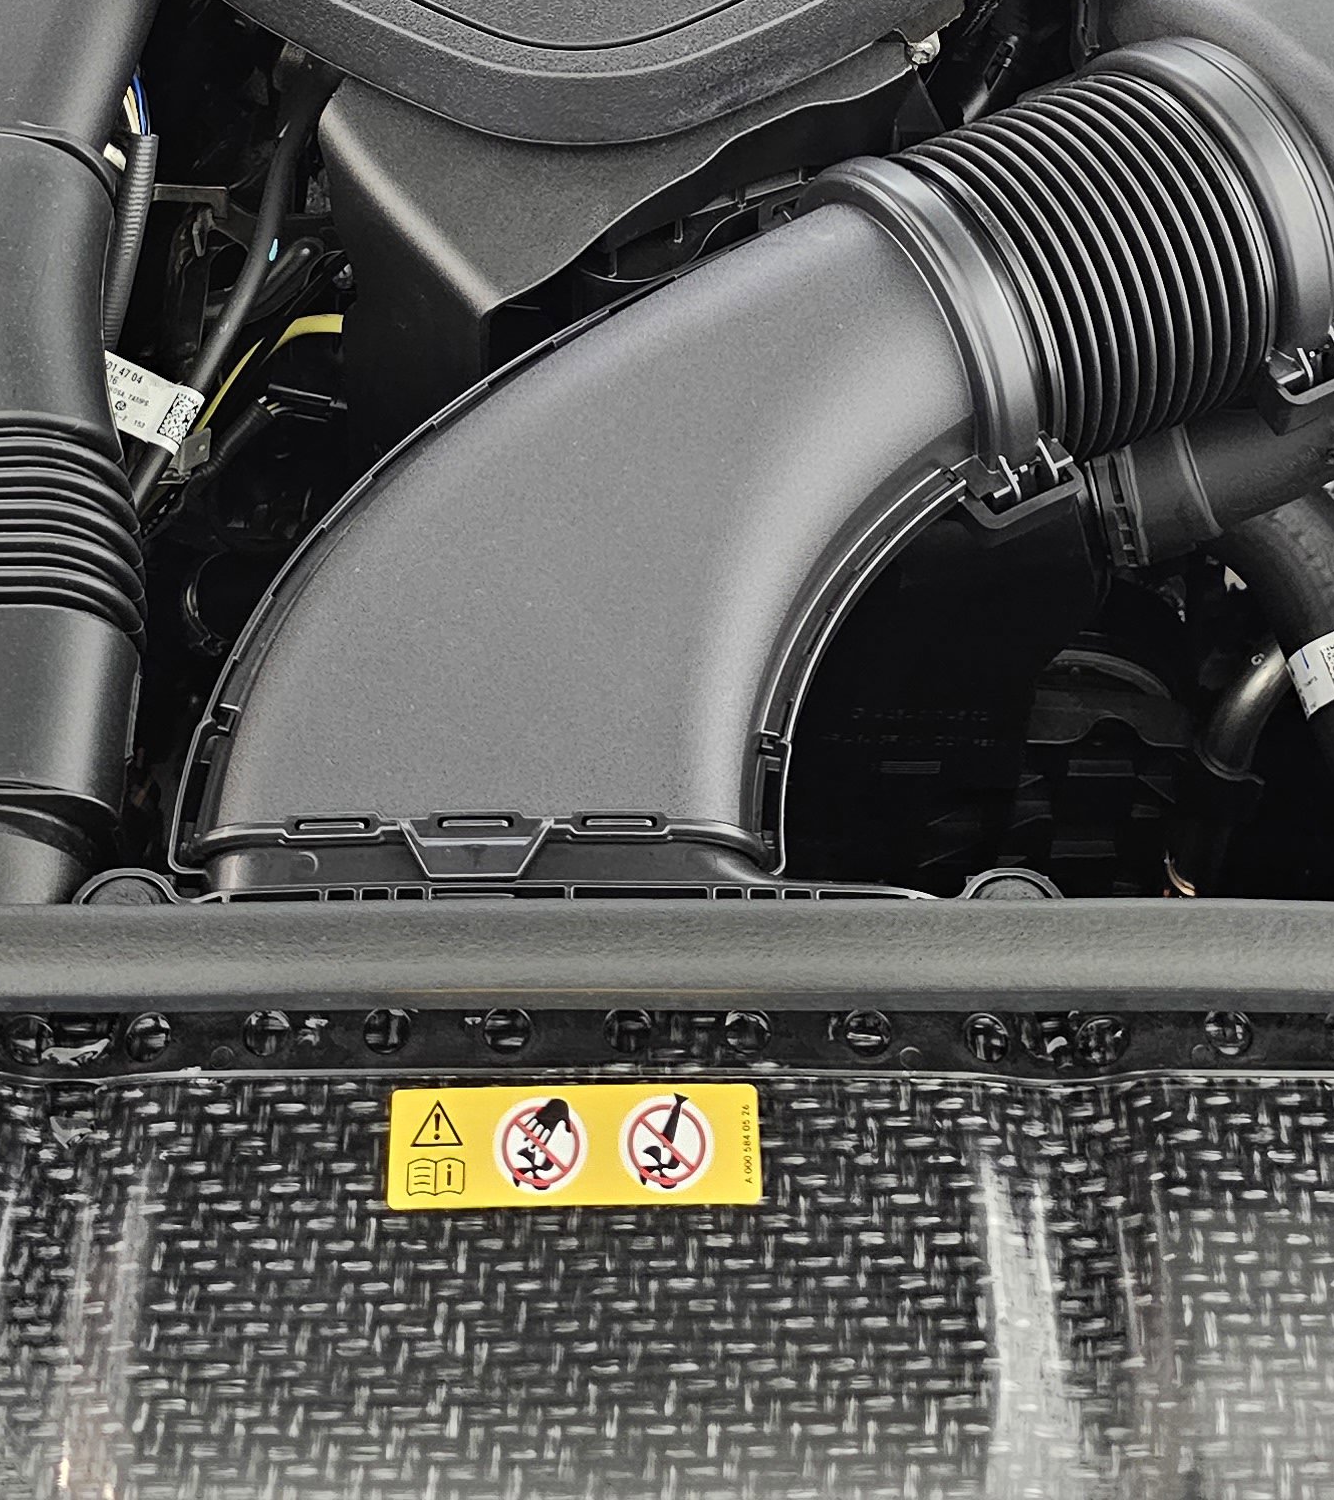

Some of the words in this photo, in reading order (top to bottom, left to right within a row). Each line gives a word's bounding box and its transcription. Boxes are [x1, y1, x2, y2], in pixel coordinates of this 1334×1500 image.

[119, 367, 131, 378] 47
[131, 372, 143, 384] 04
[742, 1119, 751, 1131] 05
[743, 1135, 752, 1152] 584
[744, 1156, 753, 1174] 000
